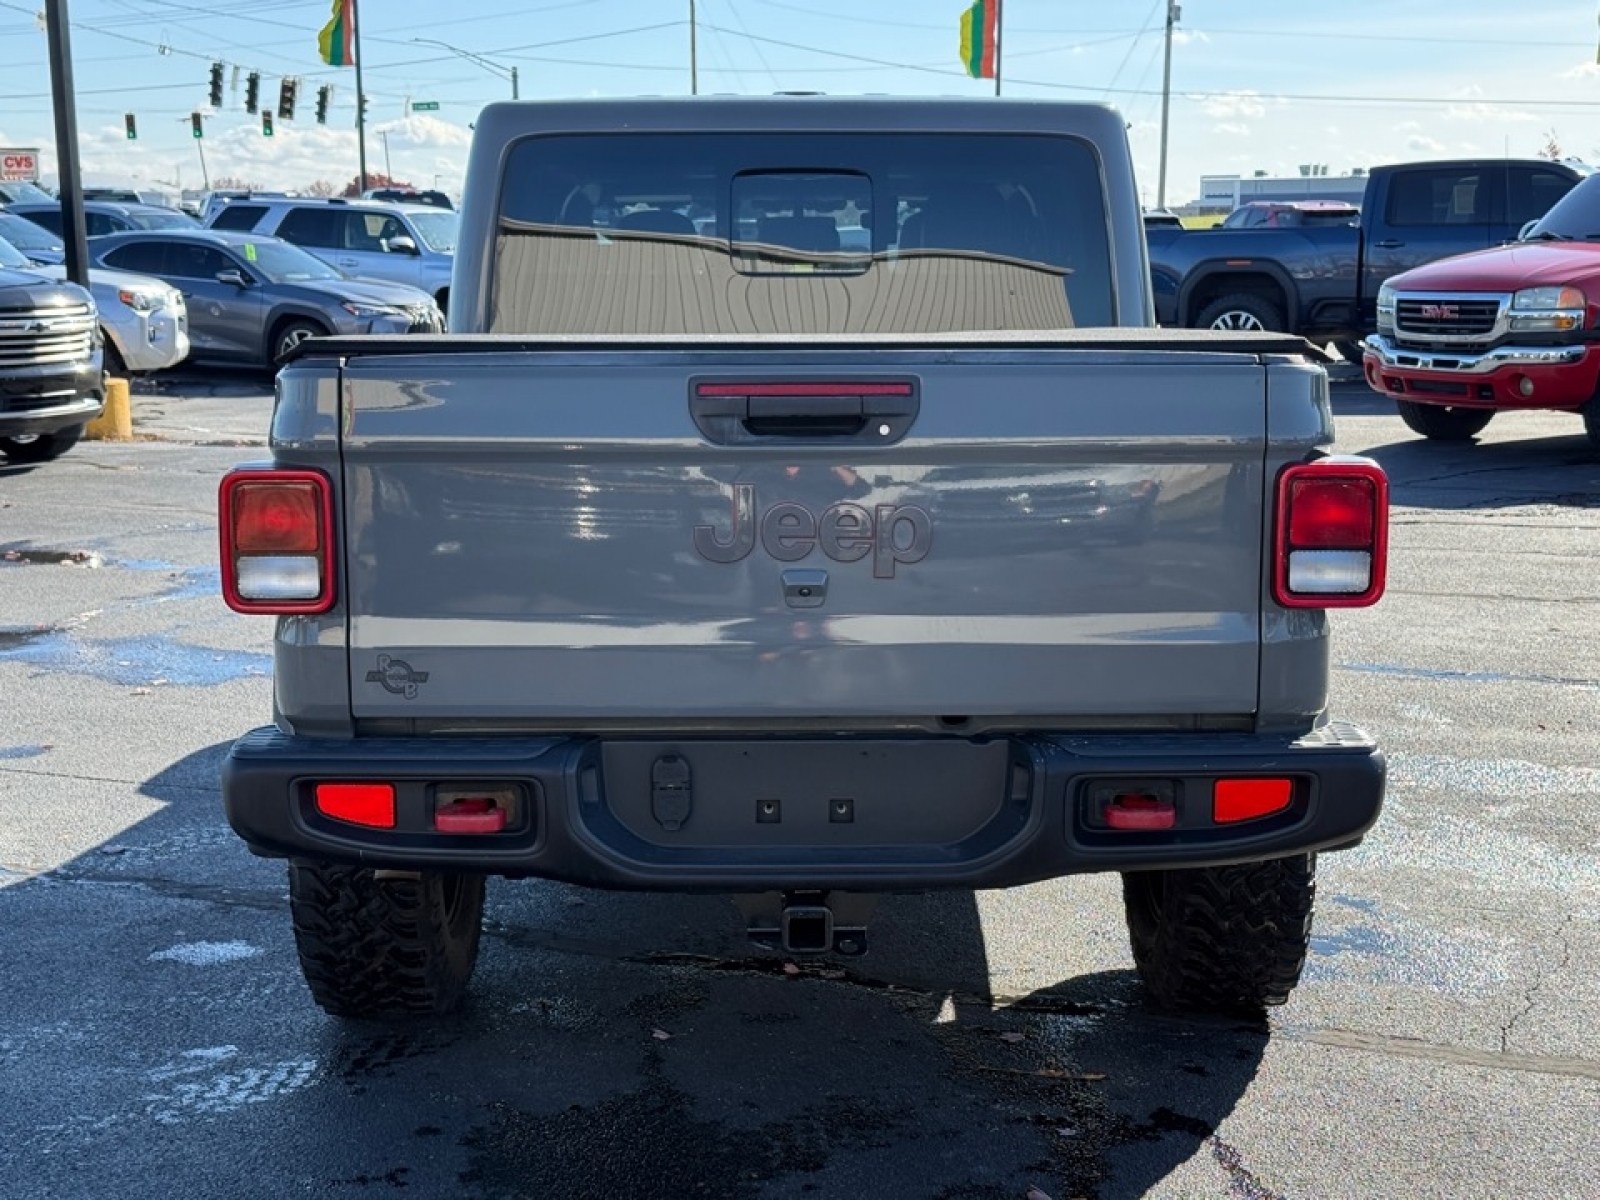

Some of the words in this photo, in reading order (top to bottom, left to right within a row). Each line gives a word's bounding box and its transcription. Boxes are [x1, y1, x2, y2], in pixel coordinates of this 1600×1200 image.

[4, 156, 33, 168] CVS
[1421, 304, 1459, 319] GMC
[693, 483, 933, 578] Jeep
